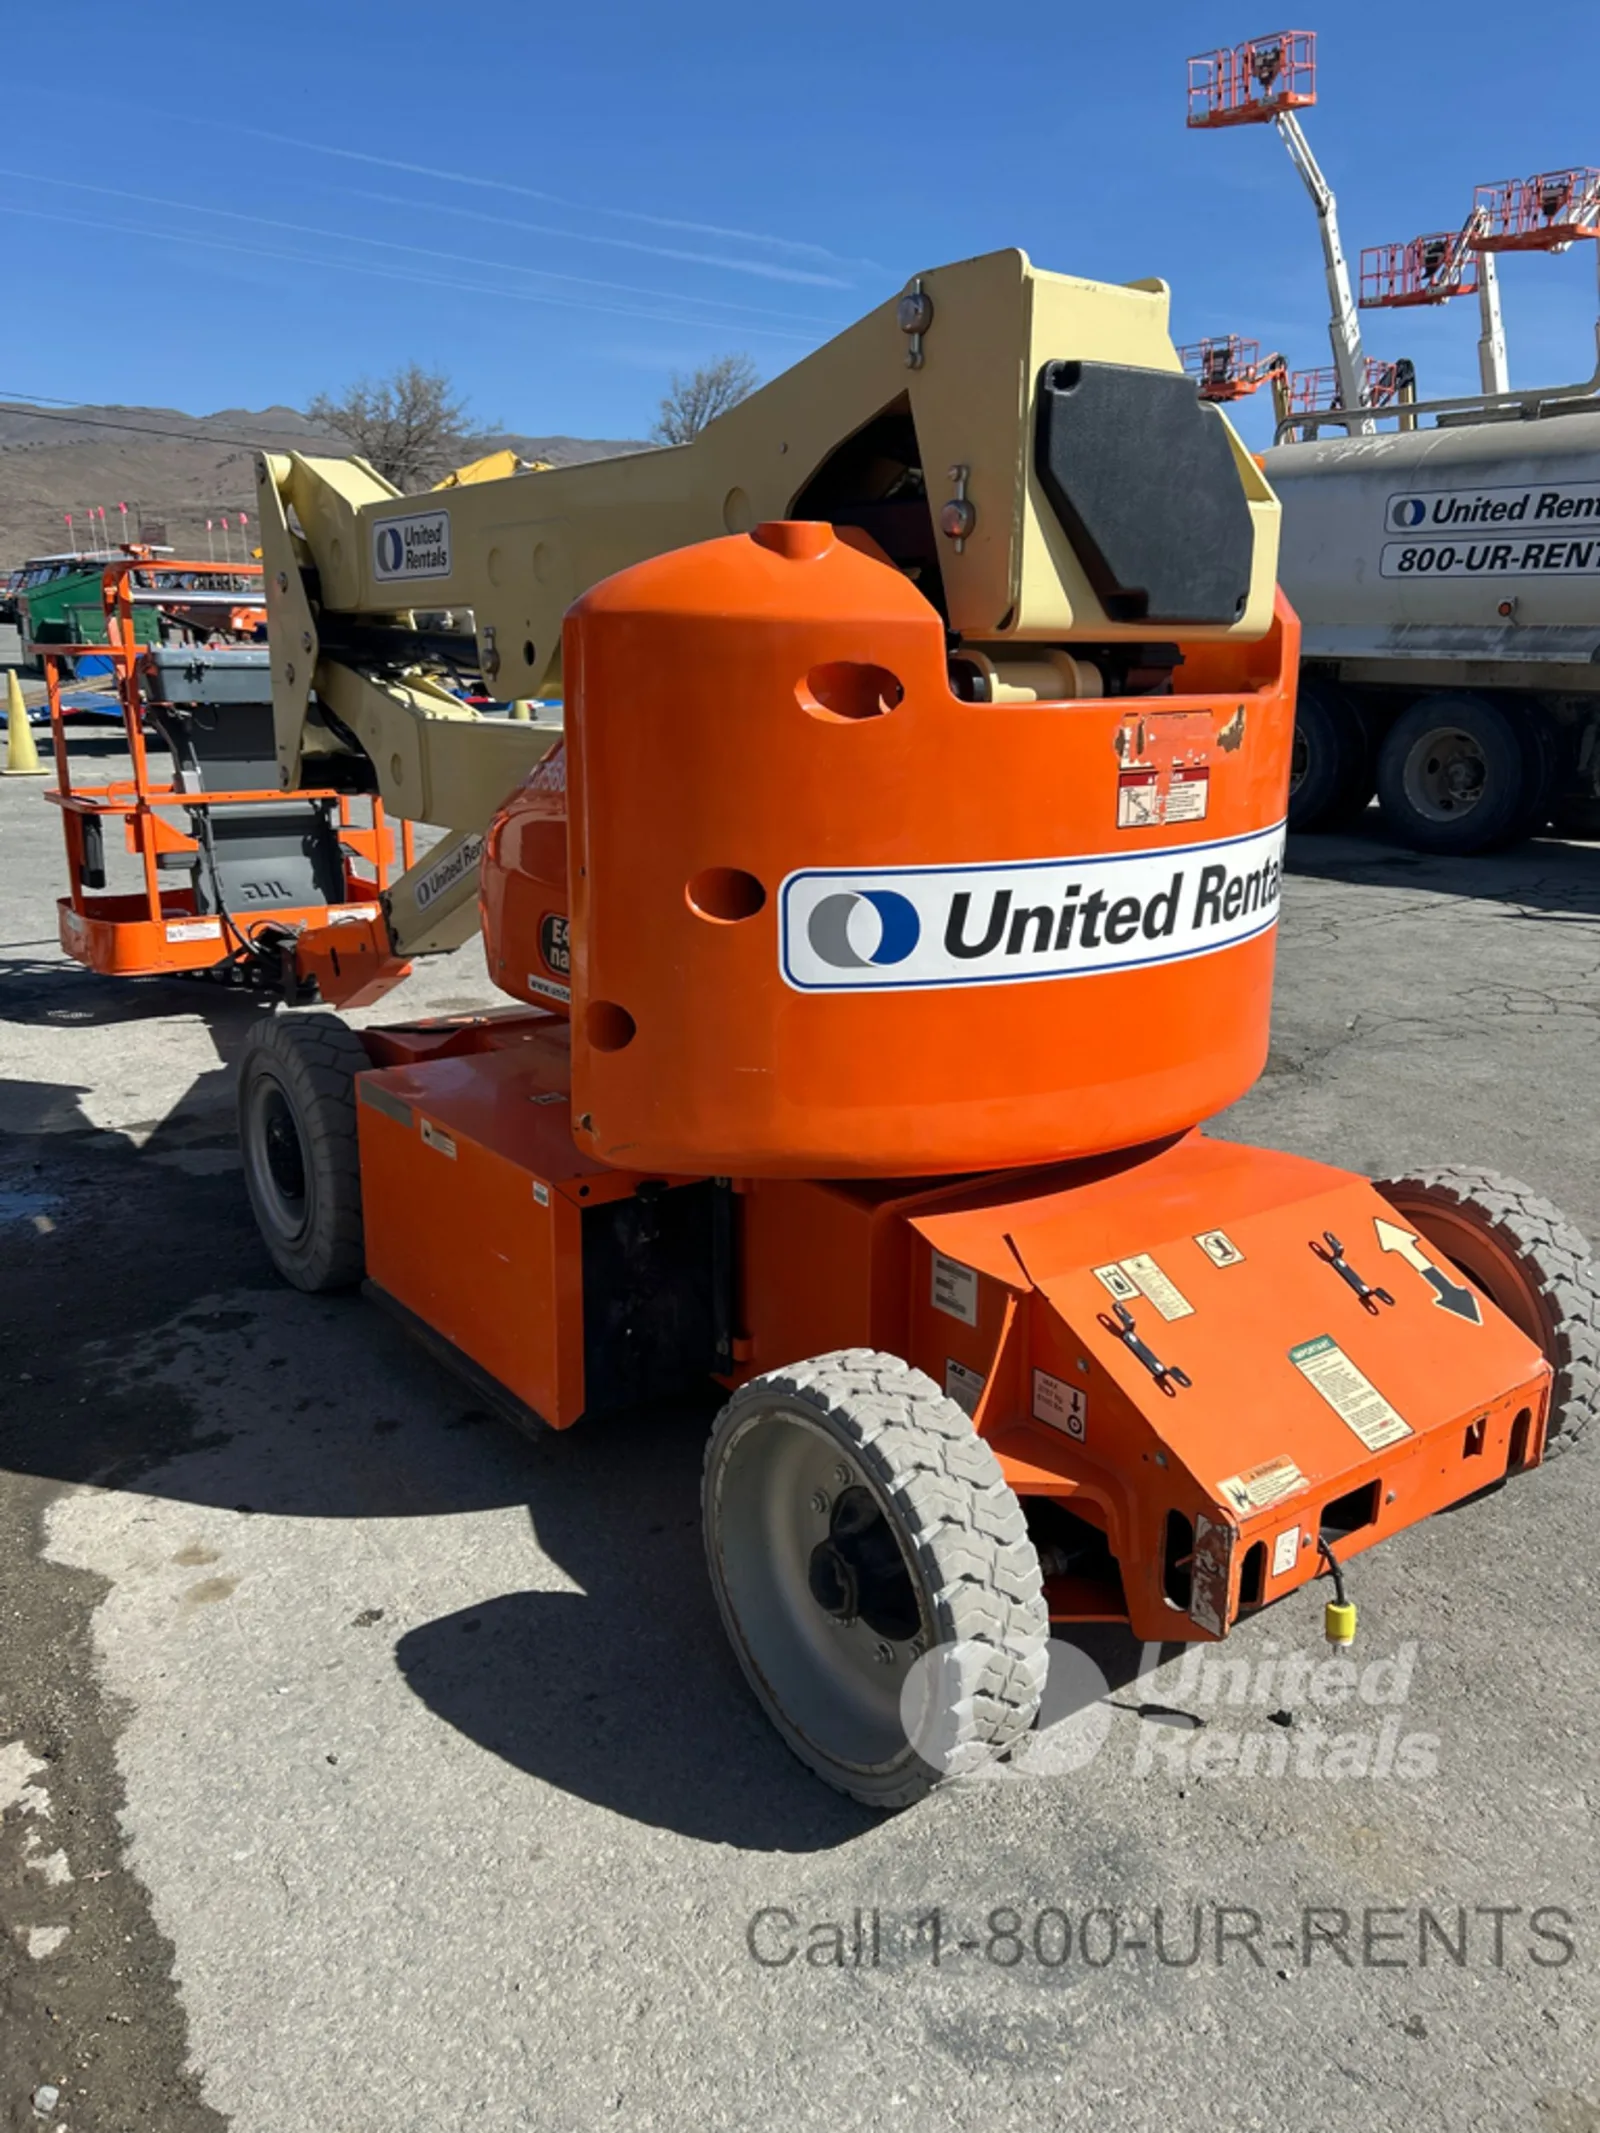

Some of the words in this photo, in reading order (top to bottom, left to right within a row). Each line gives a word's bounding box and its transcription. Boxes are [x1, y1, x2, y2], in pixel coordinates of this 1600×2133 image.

[1432, 494, 1530, 524] United
[404, 521, 443, 546] United
[406, 546, 447, 569] Rentals
[1398, 542, 1600, 572] 800-UR-REN
[429, 851, 463, 894] United
[944, 872, 1184, 960] United
